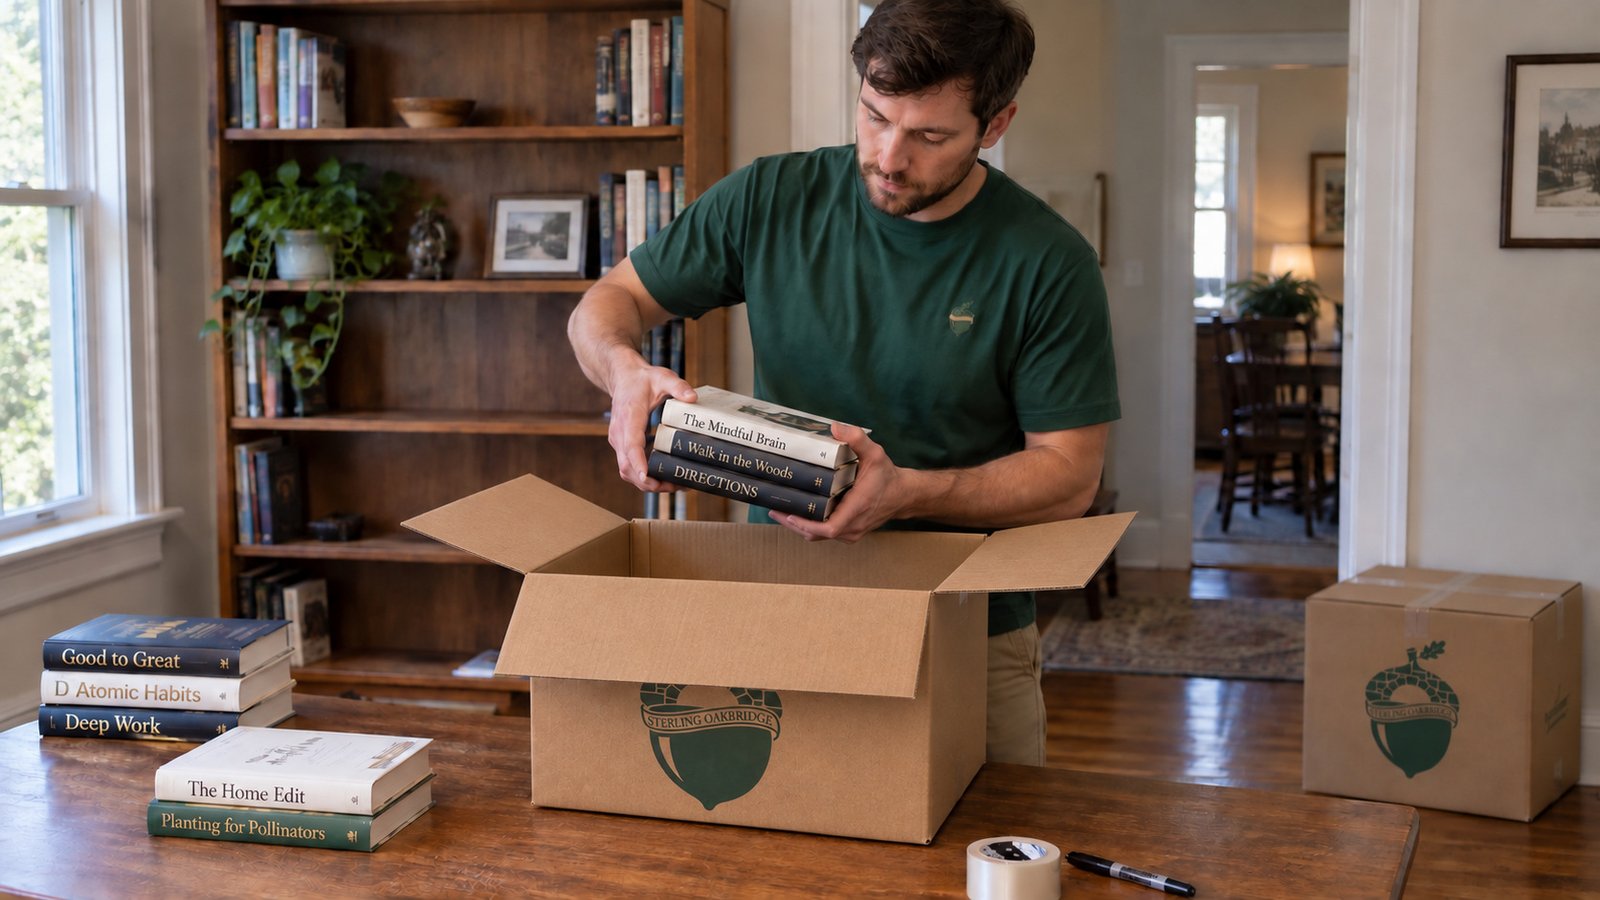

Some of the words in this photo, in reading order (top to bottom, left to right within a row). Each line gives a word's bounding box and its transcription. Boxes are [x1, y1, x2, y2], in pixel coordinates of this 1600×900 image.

[683, 412, 706, 429] The
[708, 419, 753, 442] Mindful
[756, 433, 787, 450] Brain
[674, 439, 682, 451] A
[688, 441, 716, 460] Walk
[718, 450, 730, 463] in
[732, 454, 752, 469] the
[755, 458, 794, 480] Woods
[674, 465, 759, 498] DIRECTIONS
[62, 648, 107, 667] Good
[111, 651, 129, 668] to
[132, 651, 181, 669] Great
[55, 680, 69, 697] D
[75, 681, 140, 701] Atomic
[144, 684, 201, 703] Habits
[65, 713, 110, 735] Deep
[113, 715, 161, 735] Work
[648, 714, 702, 728] STERLING
[704, 711, 773, 726] OAKBRIDGE
[187, 780, 217, 798] The
[221, 783, 269, 802] Home
[273, 786, 306, 804] Edit
[161, 813, 221, 836] Planting
[223, 817, 246, 834] for
[248, 819, 326, 840] Pollinators
